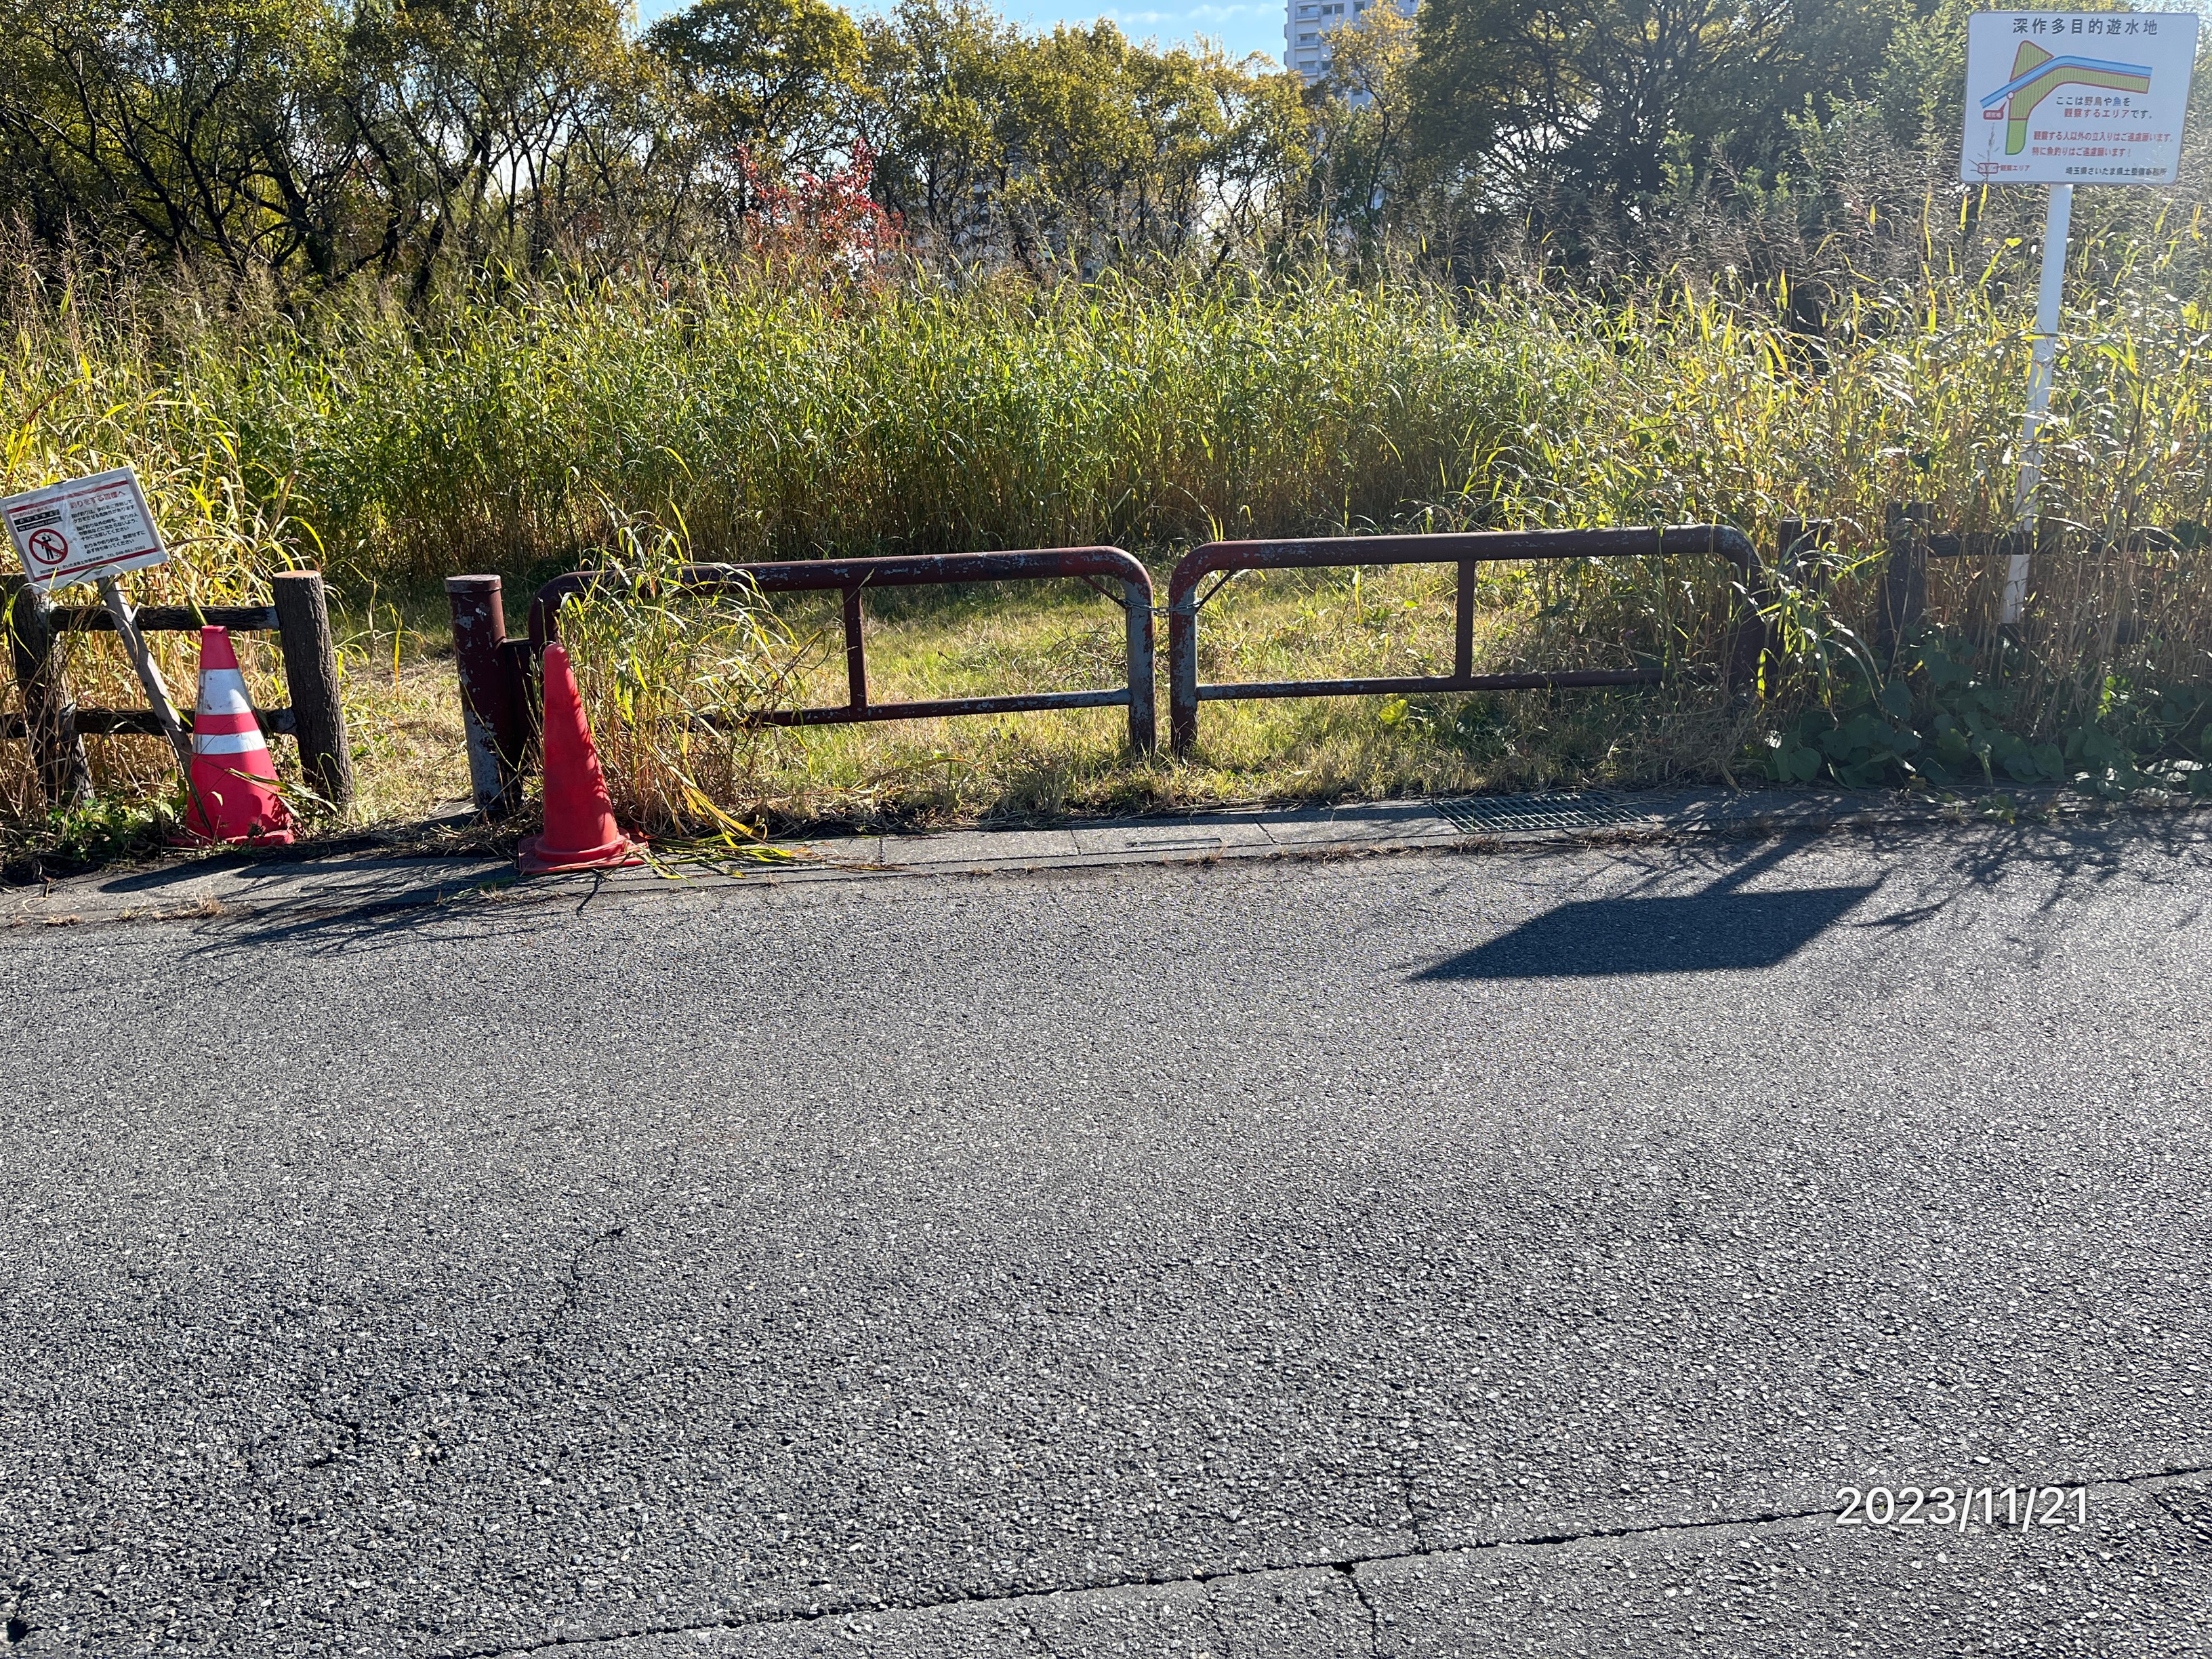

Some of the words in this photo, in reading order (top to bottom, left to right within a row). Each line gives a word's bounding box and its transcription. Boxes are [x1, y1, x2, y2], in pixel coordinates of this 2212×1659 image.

[2013, 18, 2158, 35] 深作多目的遊水地
[2056, 96, 2131, 106] ここは野鳥や魚を
[2064, 108, 2152, 119] 観察するエリアです。
[70, 491, 126, 509] 釣りをする皆様へ
